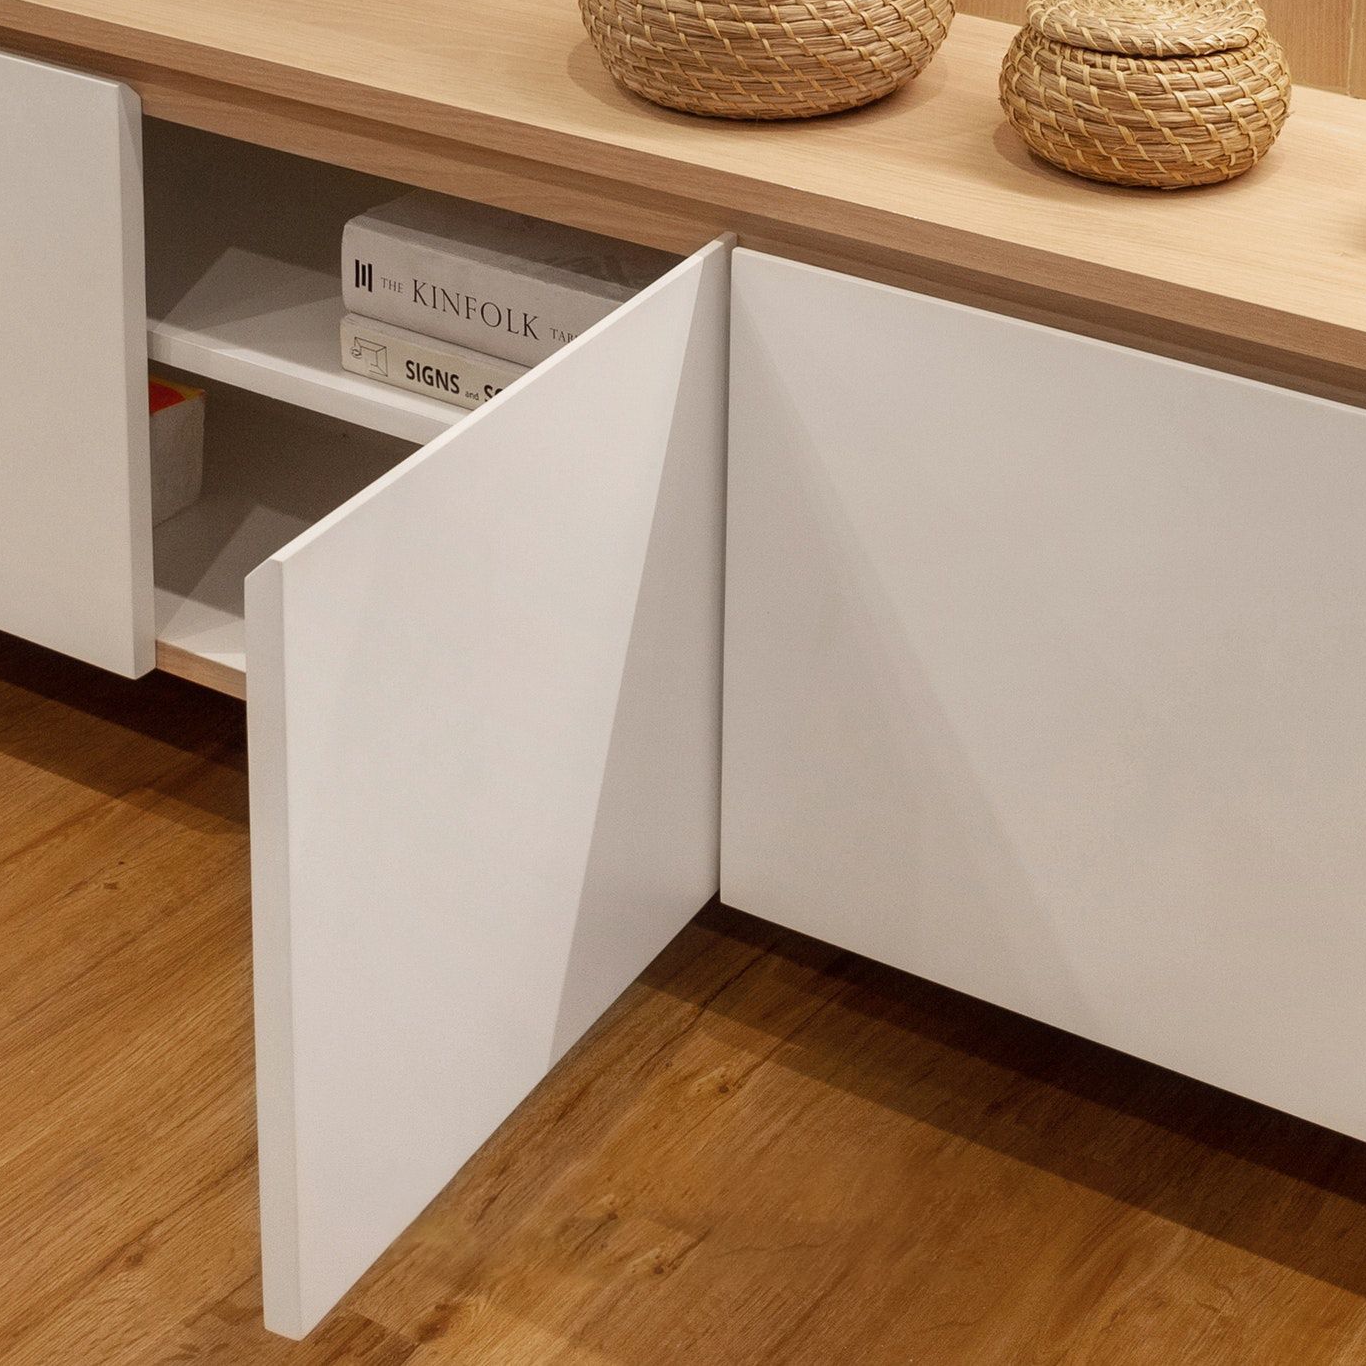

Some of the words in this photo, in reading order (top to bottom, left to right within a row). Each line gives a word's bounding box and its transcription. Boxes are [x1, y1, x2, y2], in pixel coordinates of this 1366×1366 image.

[381, 277, 404, 293] THE
[413, 279, 540, 340] KINFOLK
[549, 328, 578, 344] TAB
[405, 360, 460, 394] SIGNS
[465, 390, 479, 401] and
